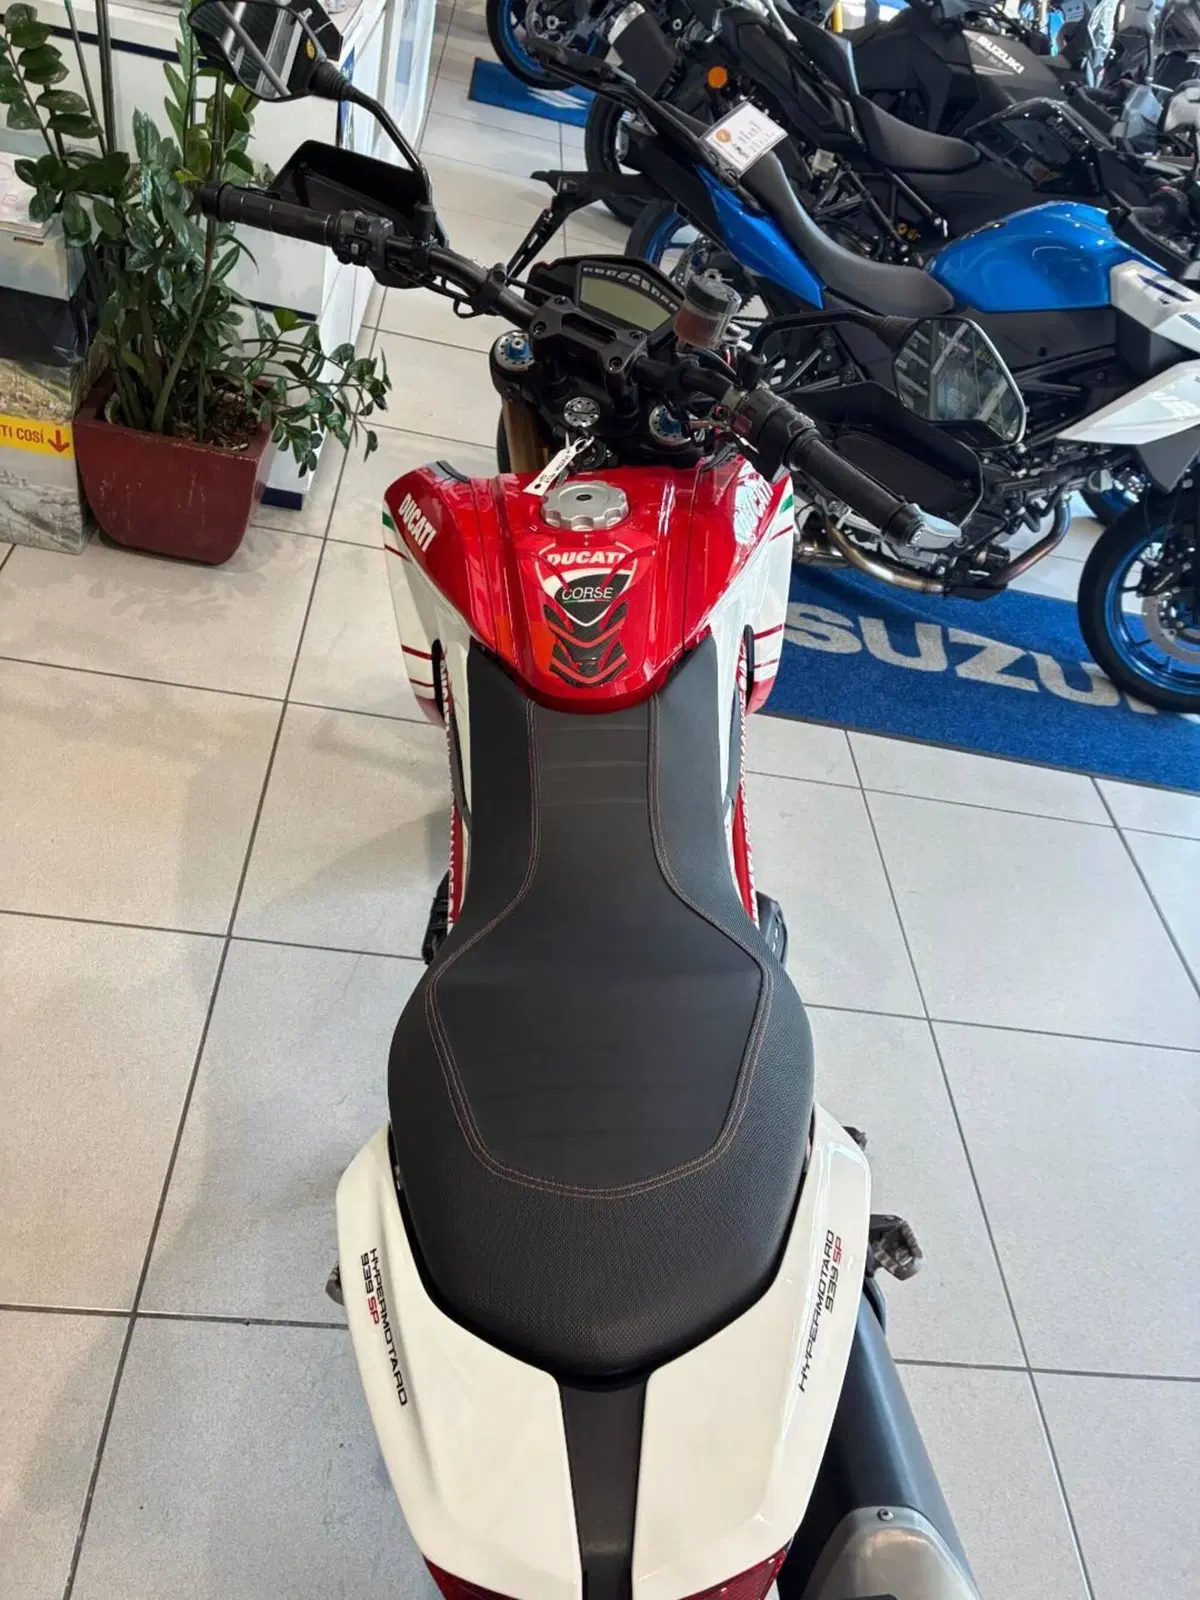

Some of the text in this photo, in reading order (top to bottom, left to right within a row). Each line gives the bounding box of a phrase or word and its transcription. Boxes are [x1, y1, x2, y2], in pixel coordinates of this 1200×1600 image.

[977, 35, 1025, 74] SUZUKI
[398, 493, 437, 552] DUCATI
[546, 551, 627, 566] DUCATI
[562, 587, 614, 600] CORSE
[784, 602, 1160, 716] SUZU
[361, 1253, 380, 1325] 939 SP
[799, 1229, 835, 1393] HYPERMOTARD
[825, 1236, 843, 1314] 939 SP
[370, 1248, 408, 1406] HYPERMOTARD
